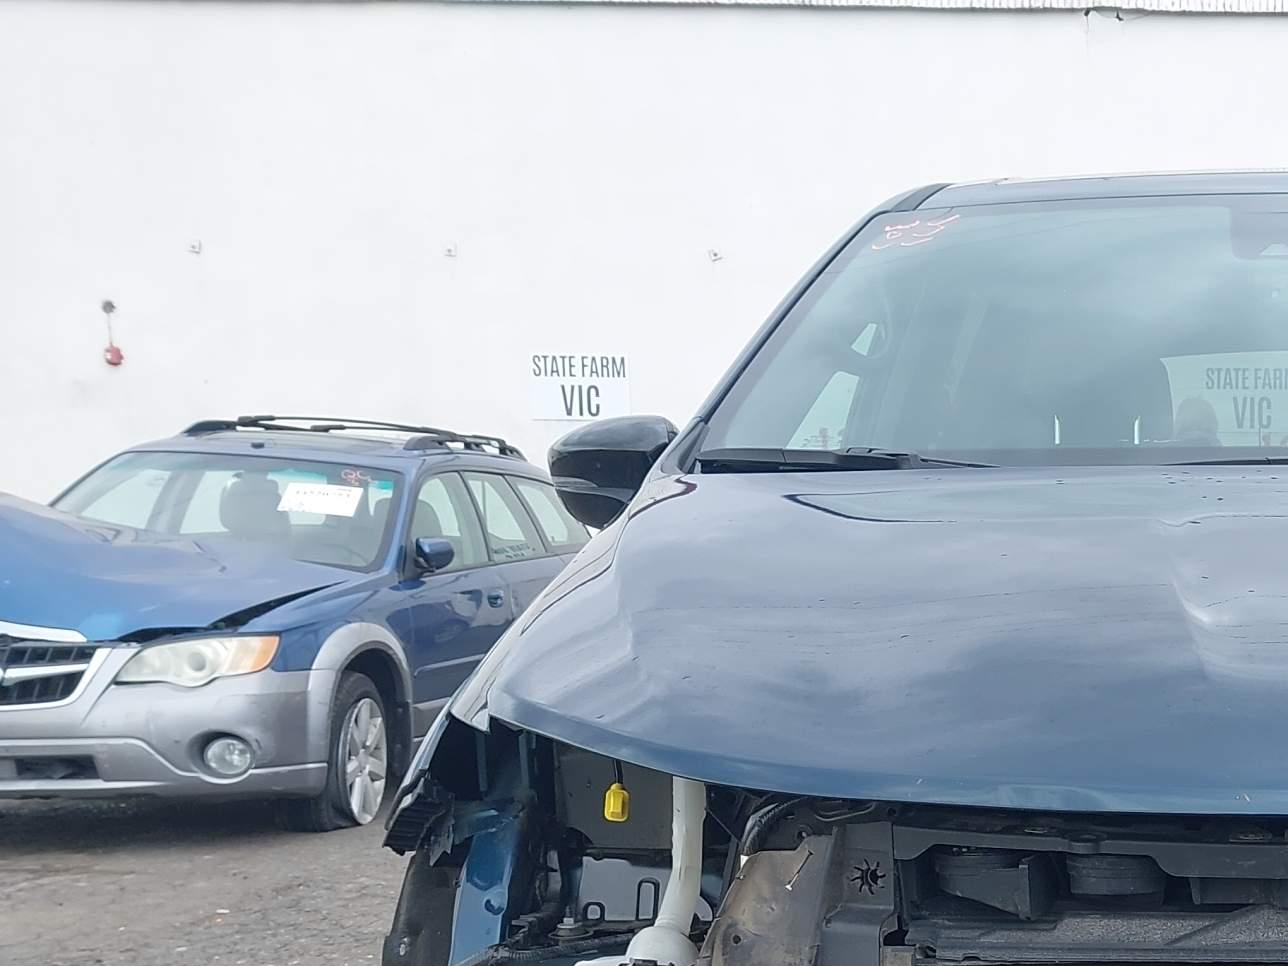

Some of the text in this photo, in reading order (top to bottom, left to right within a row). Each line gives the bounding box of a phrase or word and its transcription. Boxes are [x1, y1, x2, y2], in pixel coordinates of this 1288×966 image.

[532, 355, 626, 378] STATE FARM
[1206, 367, 1249, 390] STATE
[560, 384, 601, 417] VIC
[1233, 396, 1272, 429] VIC
